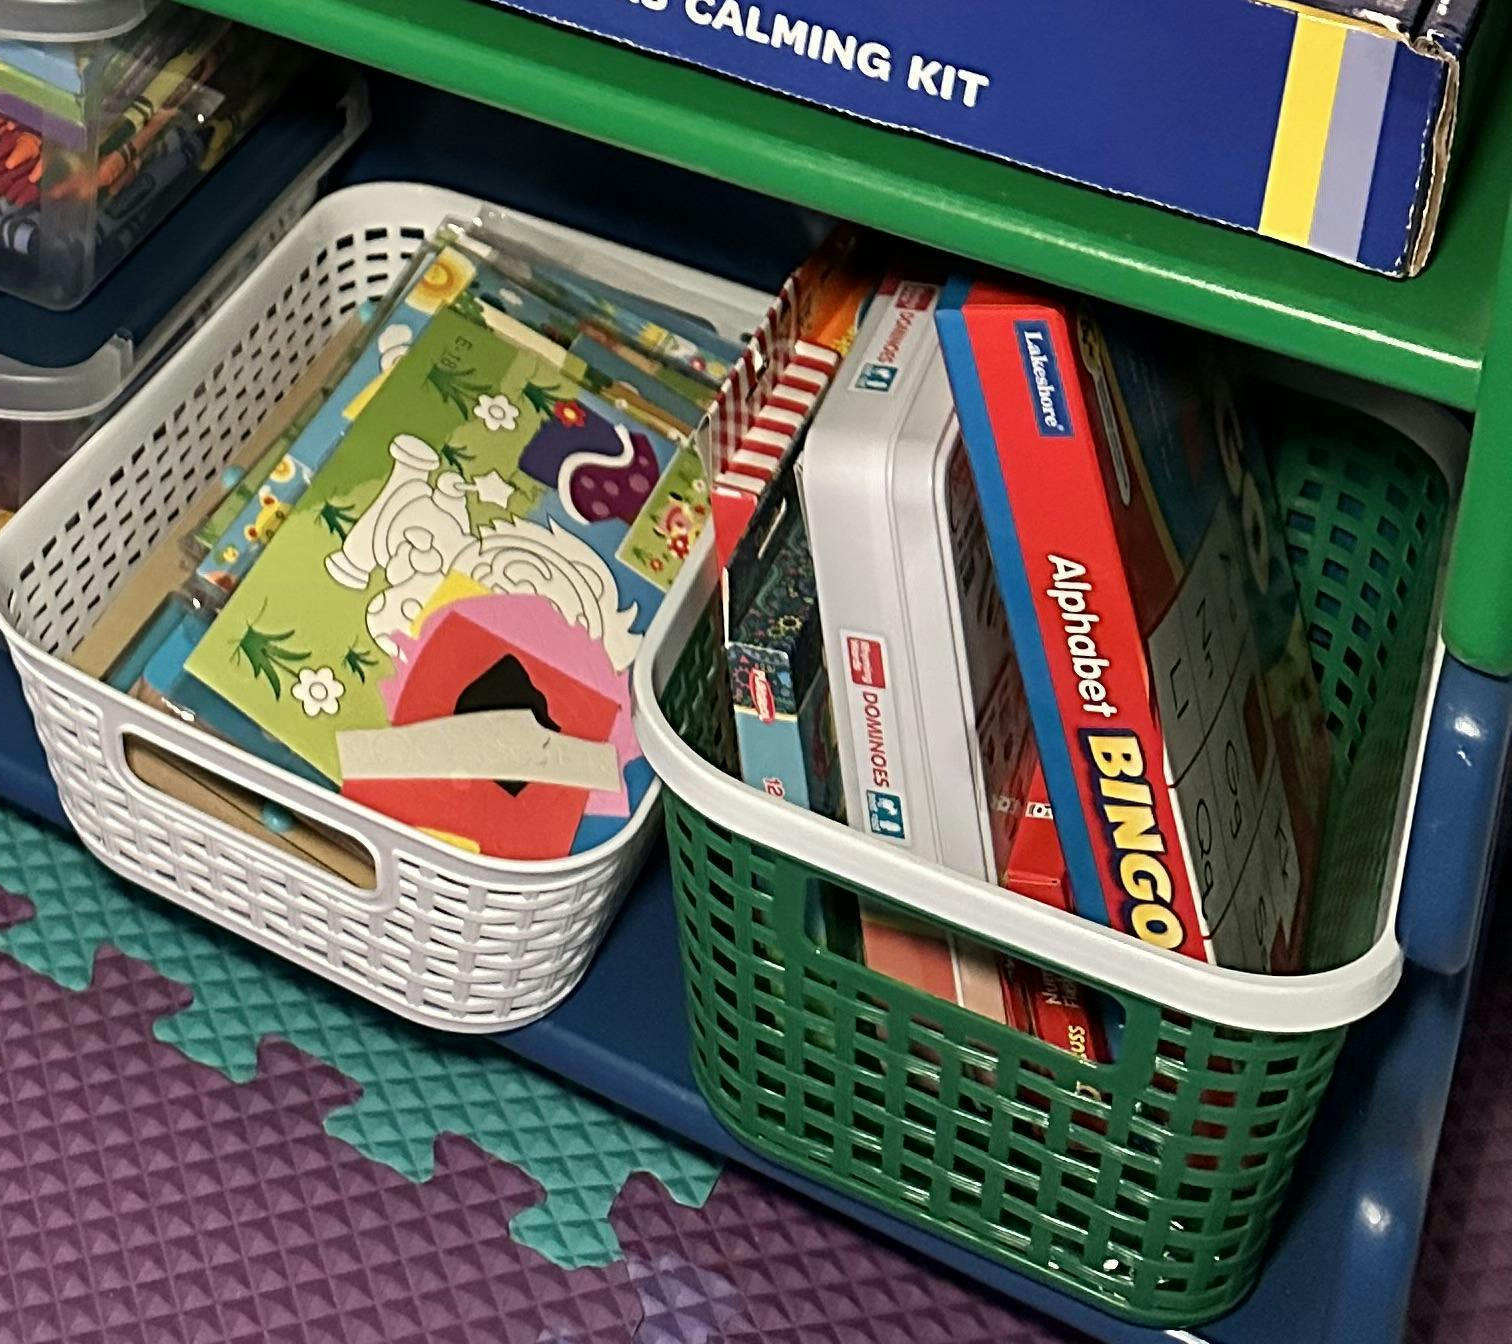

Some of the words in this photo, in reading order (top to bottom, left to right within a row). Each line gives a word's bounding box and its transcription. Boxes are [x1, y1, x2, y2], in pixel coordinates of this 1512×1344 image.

[907, 55, 991, 109] KIT
[1024, 330, 1059, 429] Lakeshore
[862, 691, 890, 789] DOMINOES
[1046, 554, 1118, 718] Alphabet
[1088, 735, 1184, 952] BINGO
